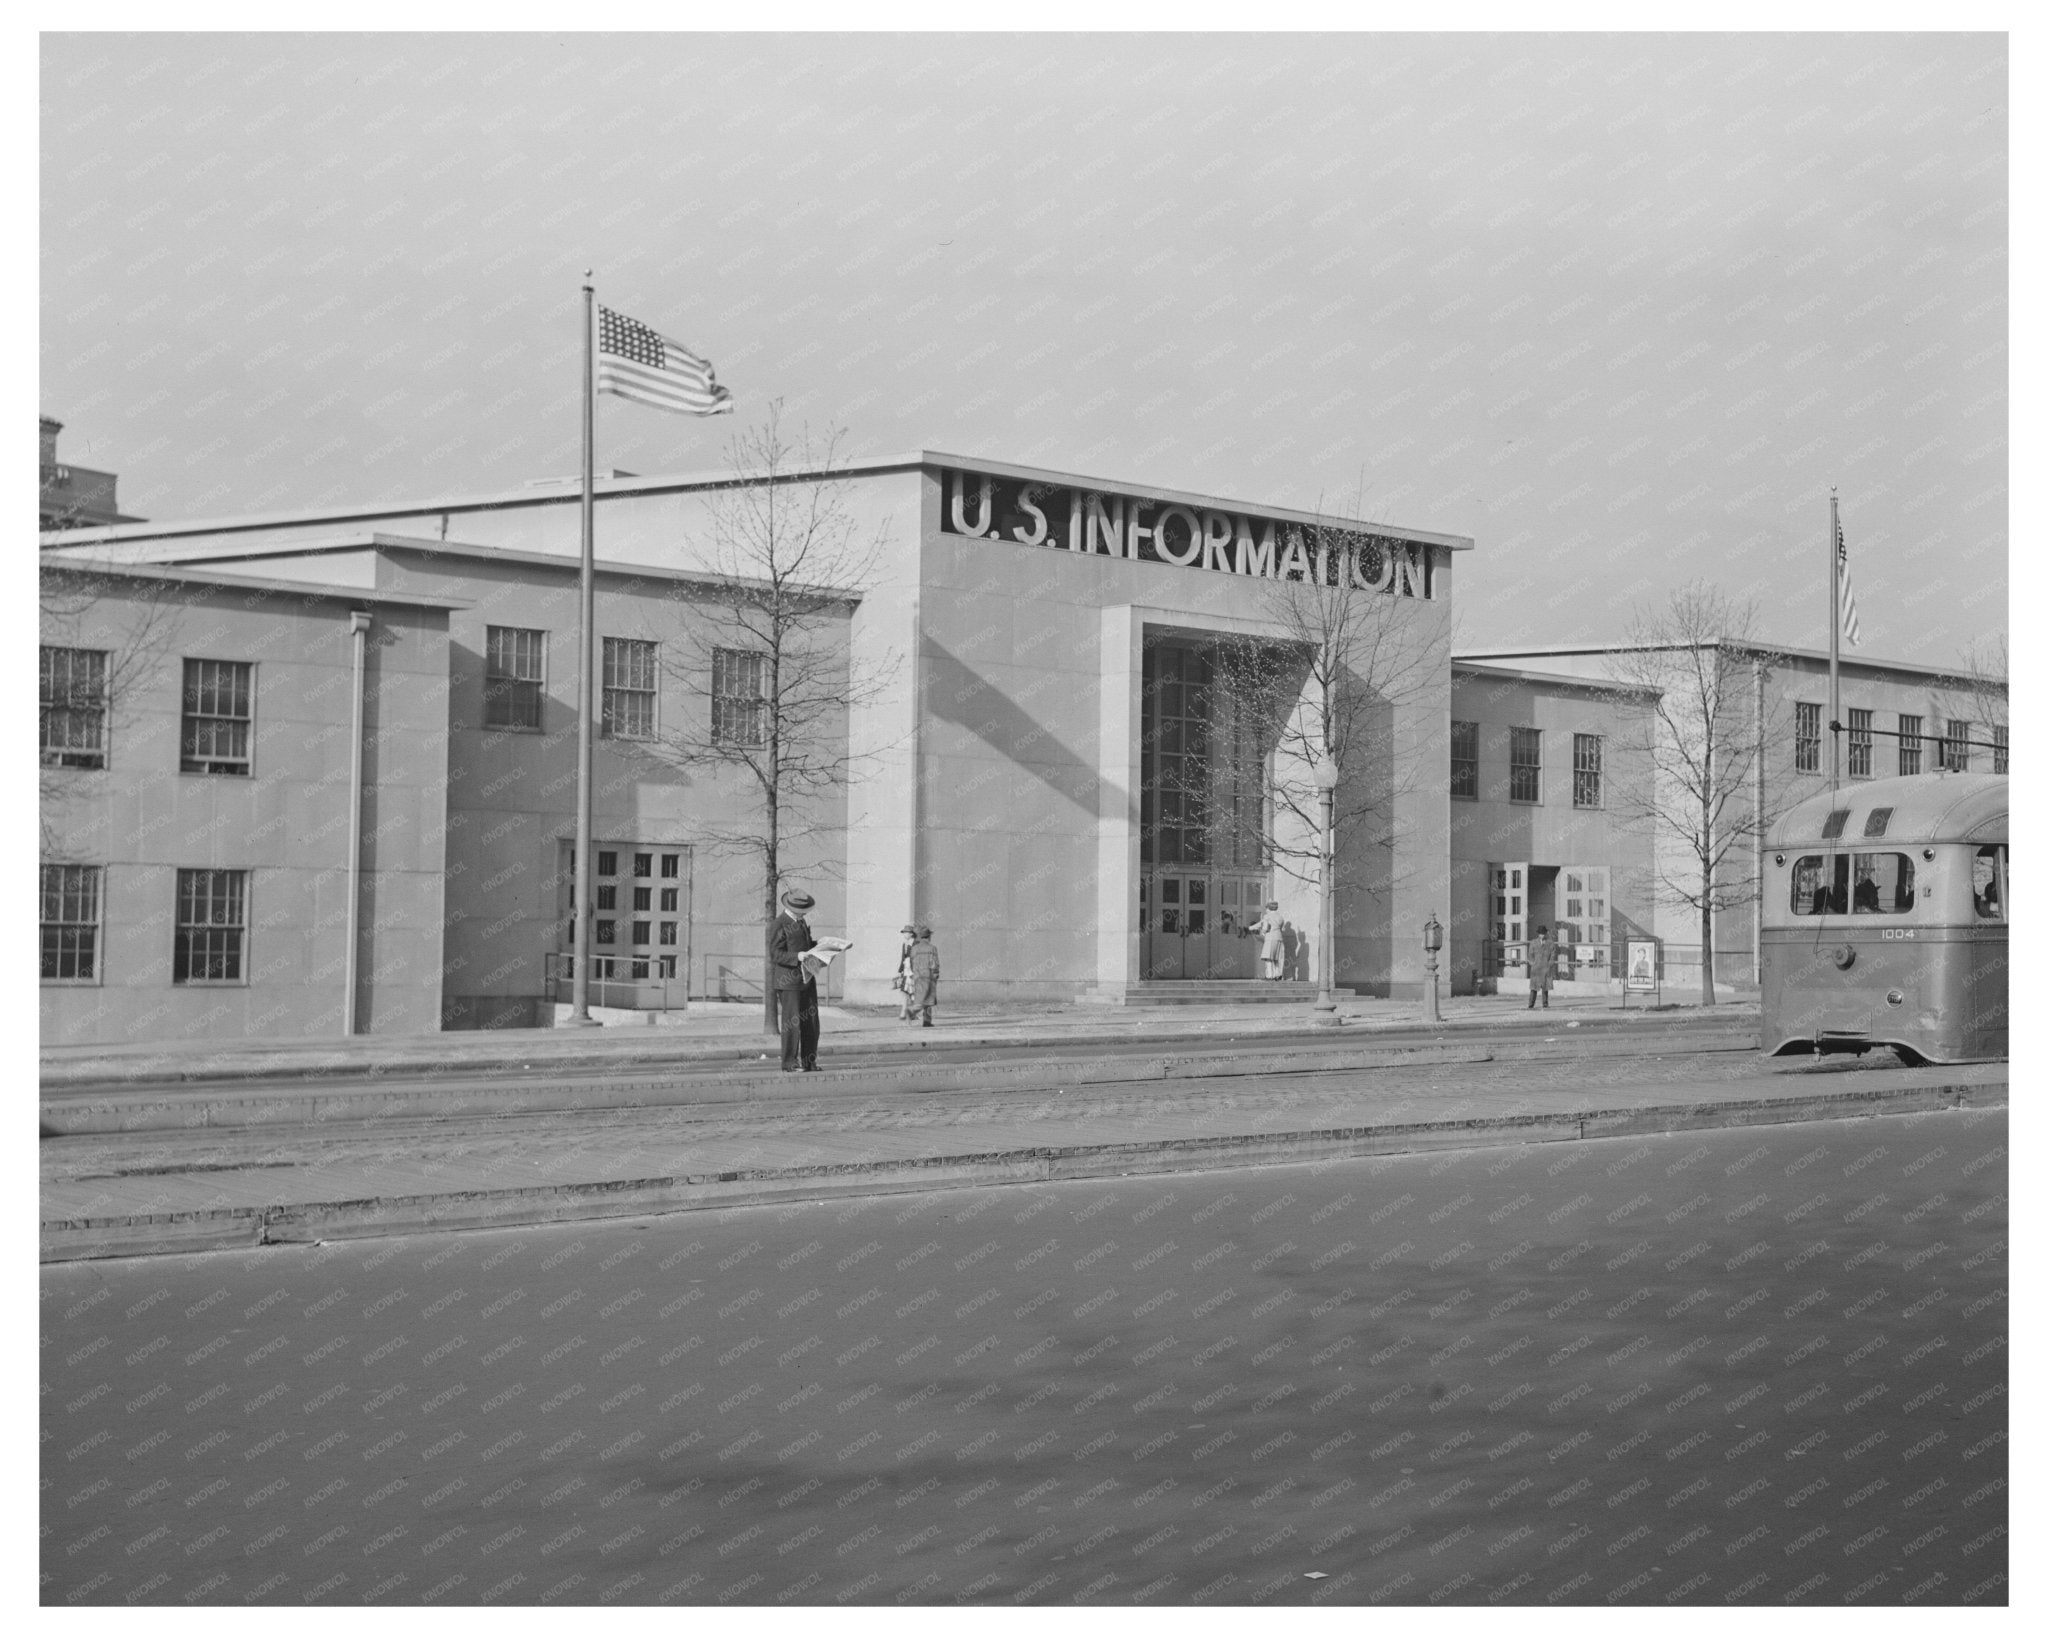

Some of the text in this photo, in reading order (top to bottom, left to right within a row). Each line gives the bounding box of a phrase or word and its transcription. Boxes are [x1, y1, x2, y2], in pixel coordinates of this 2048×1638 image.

[951, 468, 1425, 598] U. S. INFORMATION
[1882, 928, 1914, 939] 1004
